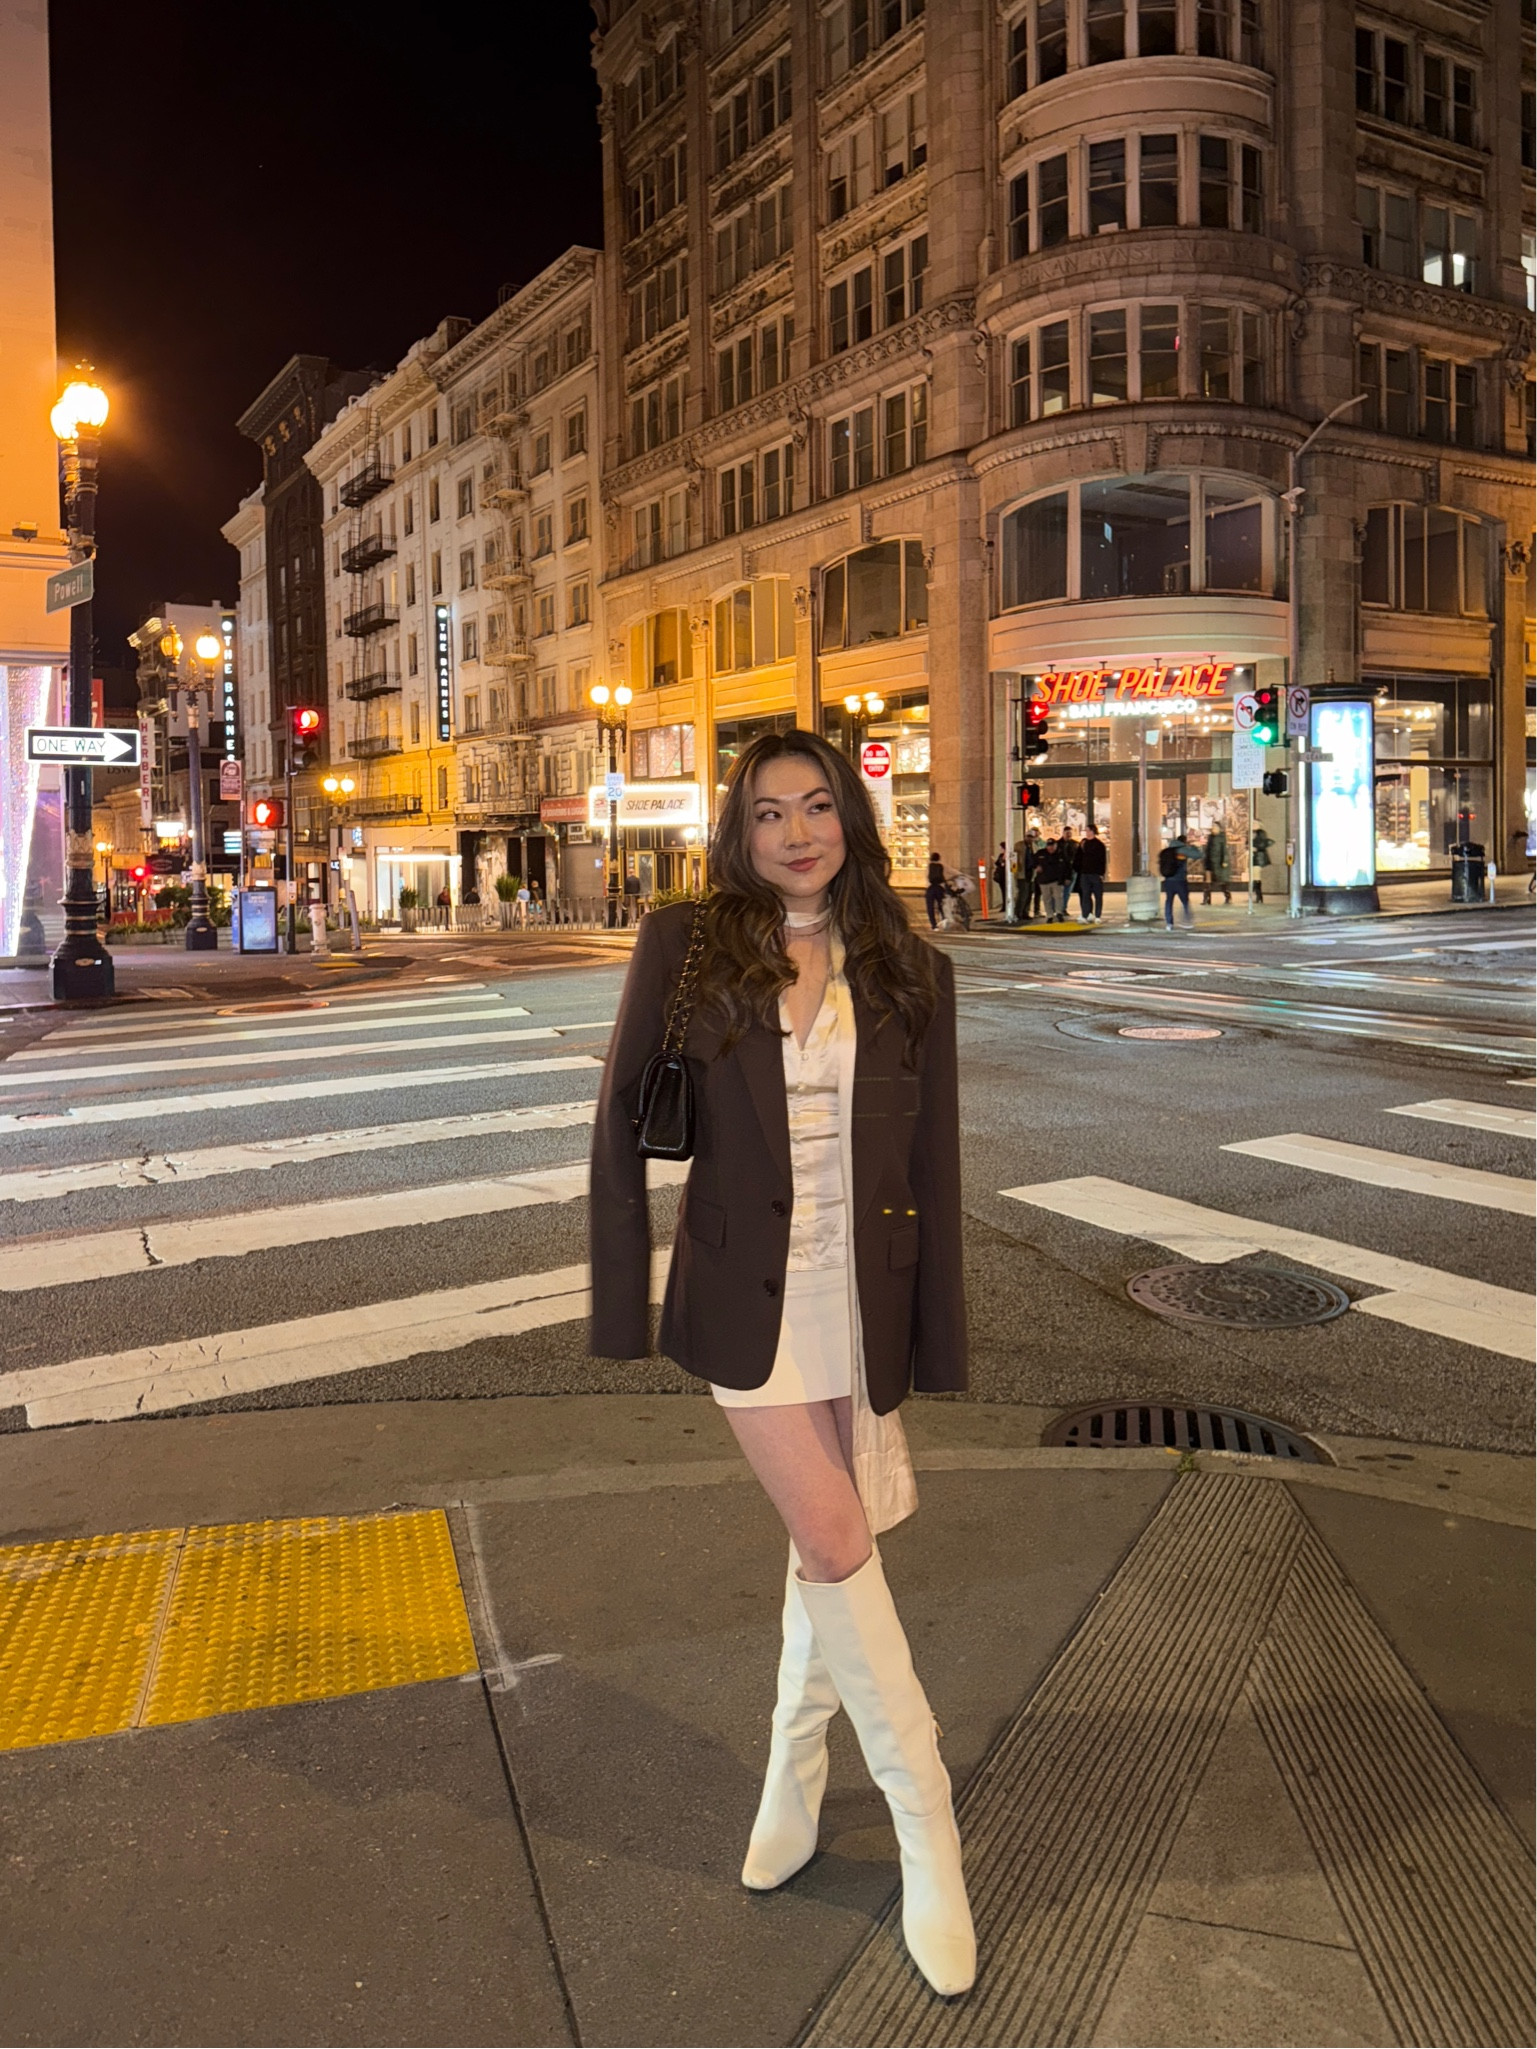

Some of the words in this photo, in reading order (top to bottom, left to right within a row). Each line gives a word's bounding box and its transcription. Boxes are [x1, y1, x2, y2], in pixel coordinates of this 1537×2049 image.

[54, 574, 84, 602] Powell
[223, 635, 233, 675] THE
[440, 658, 449, 719] BARNES
[1031, 669, 1113, 704] SHOE
[1114, 662, 1234, 701] PALACE
[224, 682, 236, 762] BARNES
[1068, 703, 1102, 719] SAN
[1103, 699, 1198, 717] FRANCISCO
[37, 738, 68, 752] ONE
[75, 739, 106, 753] WAY
[140, 722, 150, 810] HERBERT
[607, 786, 622, 797] 20
[626, 800, 649, 811] SHOE
[651, 799, 686, 811] PALACE
